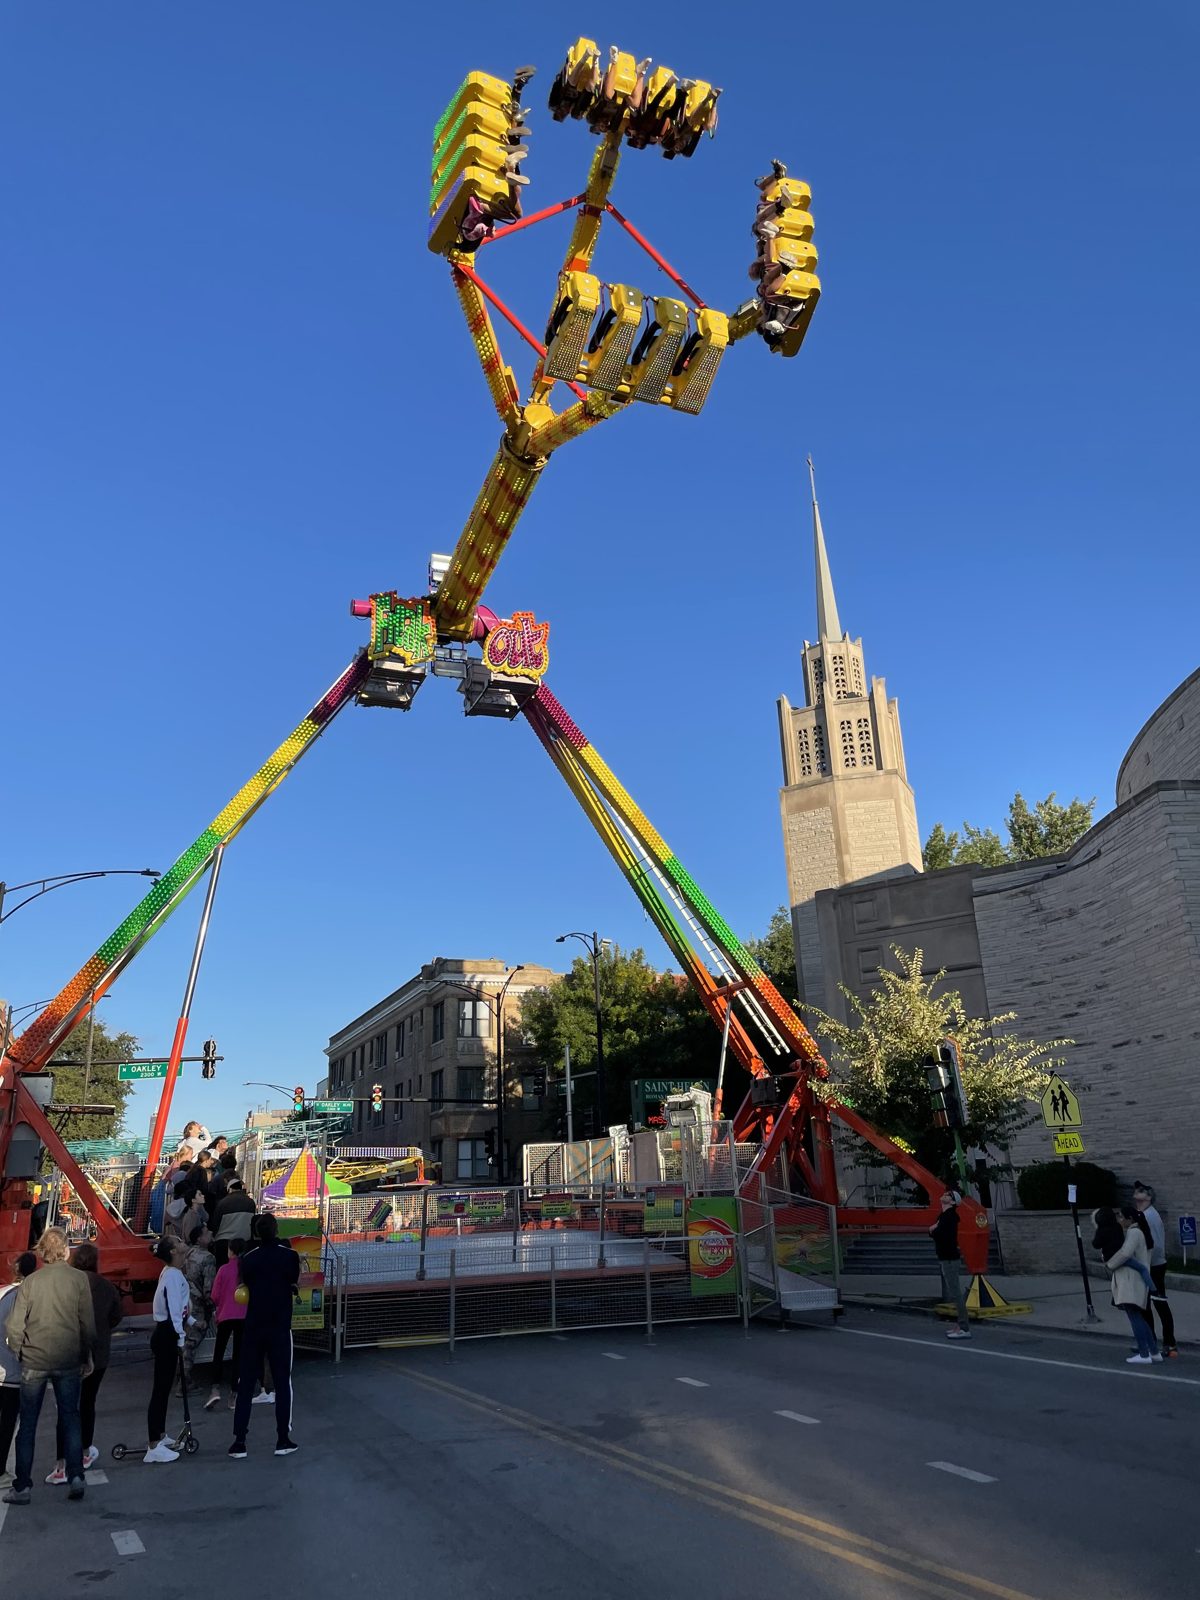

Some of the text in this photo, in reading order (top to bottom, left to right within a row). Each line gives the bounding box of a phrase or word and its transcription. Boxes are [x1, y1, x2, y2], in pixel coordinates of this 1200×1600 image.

[130, 1065, 162, 1073] OAKLEY
[644, 1081, 710, 1093] SAINT HEN
[1057, 1137, 1079, 1149] AHEAD
